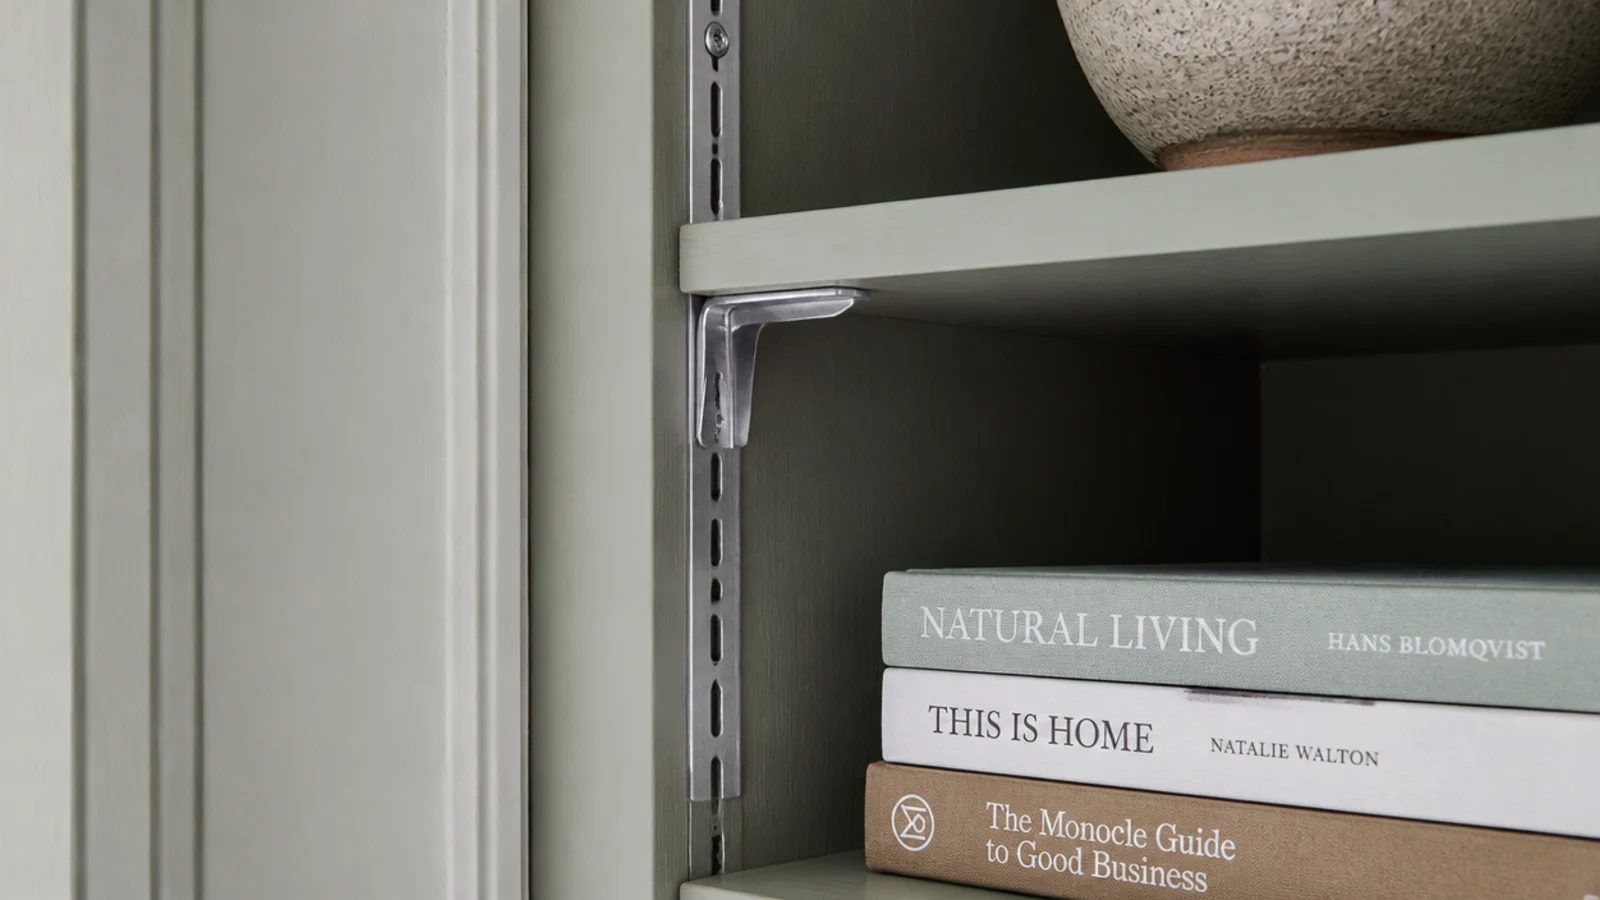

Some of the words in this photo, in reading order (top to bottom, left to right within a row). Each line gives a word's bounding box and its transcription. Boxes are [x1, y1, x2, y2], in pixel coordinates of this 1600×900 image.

[920, 605, 1099, 648] NATURAL
[1109, 614, 1260, 657] LIVING
[1327, 632, 1392, 653] HANS
[1399, 635, 1547, 662] BLOMQVIST
[928, 704, 1001, 741] THIS
[1010, 712, 1040, 744] IS
[1048, 715, 1155, 755] HOME
[1210, 737, 1290, 760] NATALIE
[1295, 744, 1380, 768] WALTON
[986, 801, 1033, 833] The
[1039, 808, 1148, 849] Monocle
[1155, 822, 1237, 861] Guide
[986, 838, 1009, 864] to
[1016, 840, 1084, 876] Good
[1091, 849, 1209, 893] Business
